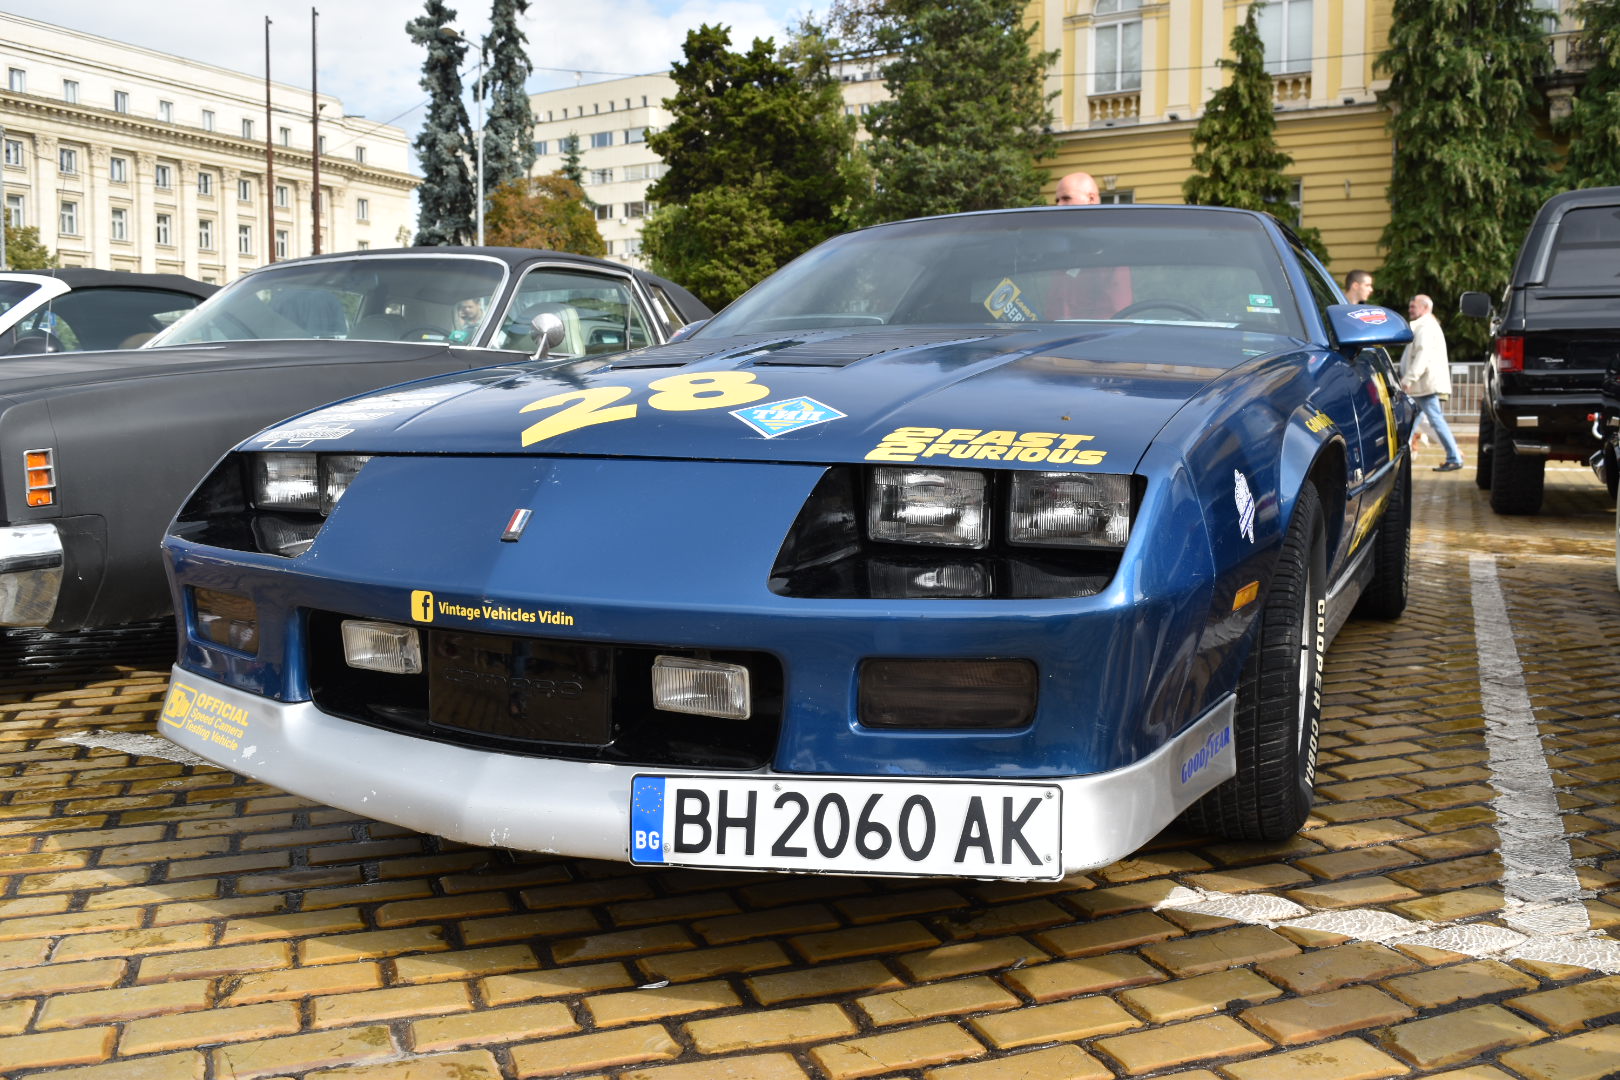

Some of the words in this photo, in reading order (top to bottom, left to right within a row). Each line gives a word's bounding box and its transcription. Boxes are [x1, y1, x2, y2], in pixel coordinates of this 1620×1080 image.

[519, 371, 771, 447] 28
[438, 601, 481, 621] Vintage
[482, 606, 536, 623] Vehicles
[538, 610, 575, 626] Vidin
[1313, 599, 1325, 709] COOPER
[190, 707, 216, 726] Speed
[214, 718, 244, 739] Camera
[196, 693, 250, 727] OFFICIAL
[185, 719, 211, 741] Testing
[211, 730, 239, 751] Vehicle
[1181, 727, 1231, 785] GOODYEAR
[1304, 718, 1319, 788] COBRA
[635, 830, 660, 850] BG
[673, 788, 758, 856] BH
[771, 791, 936, 861] 2060
[954, 795, 1044, 867] AK
